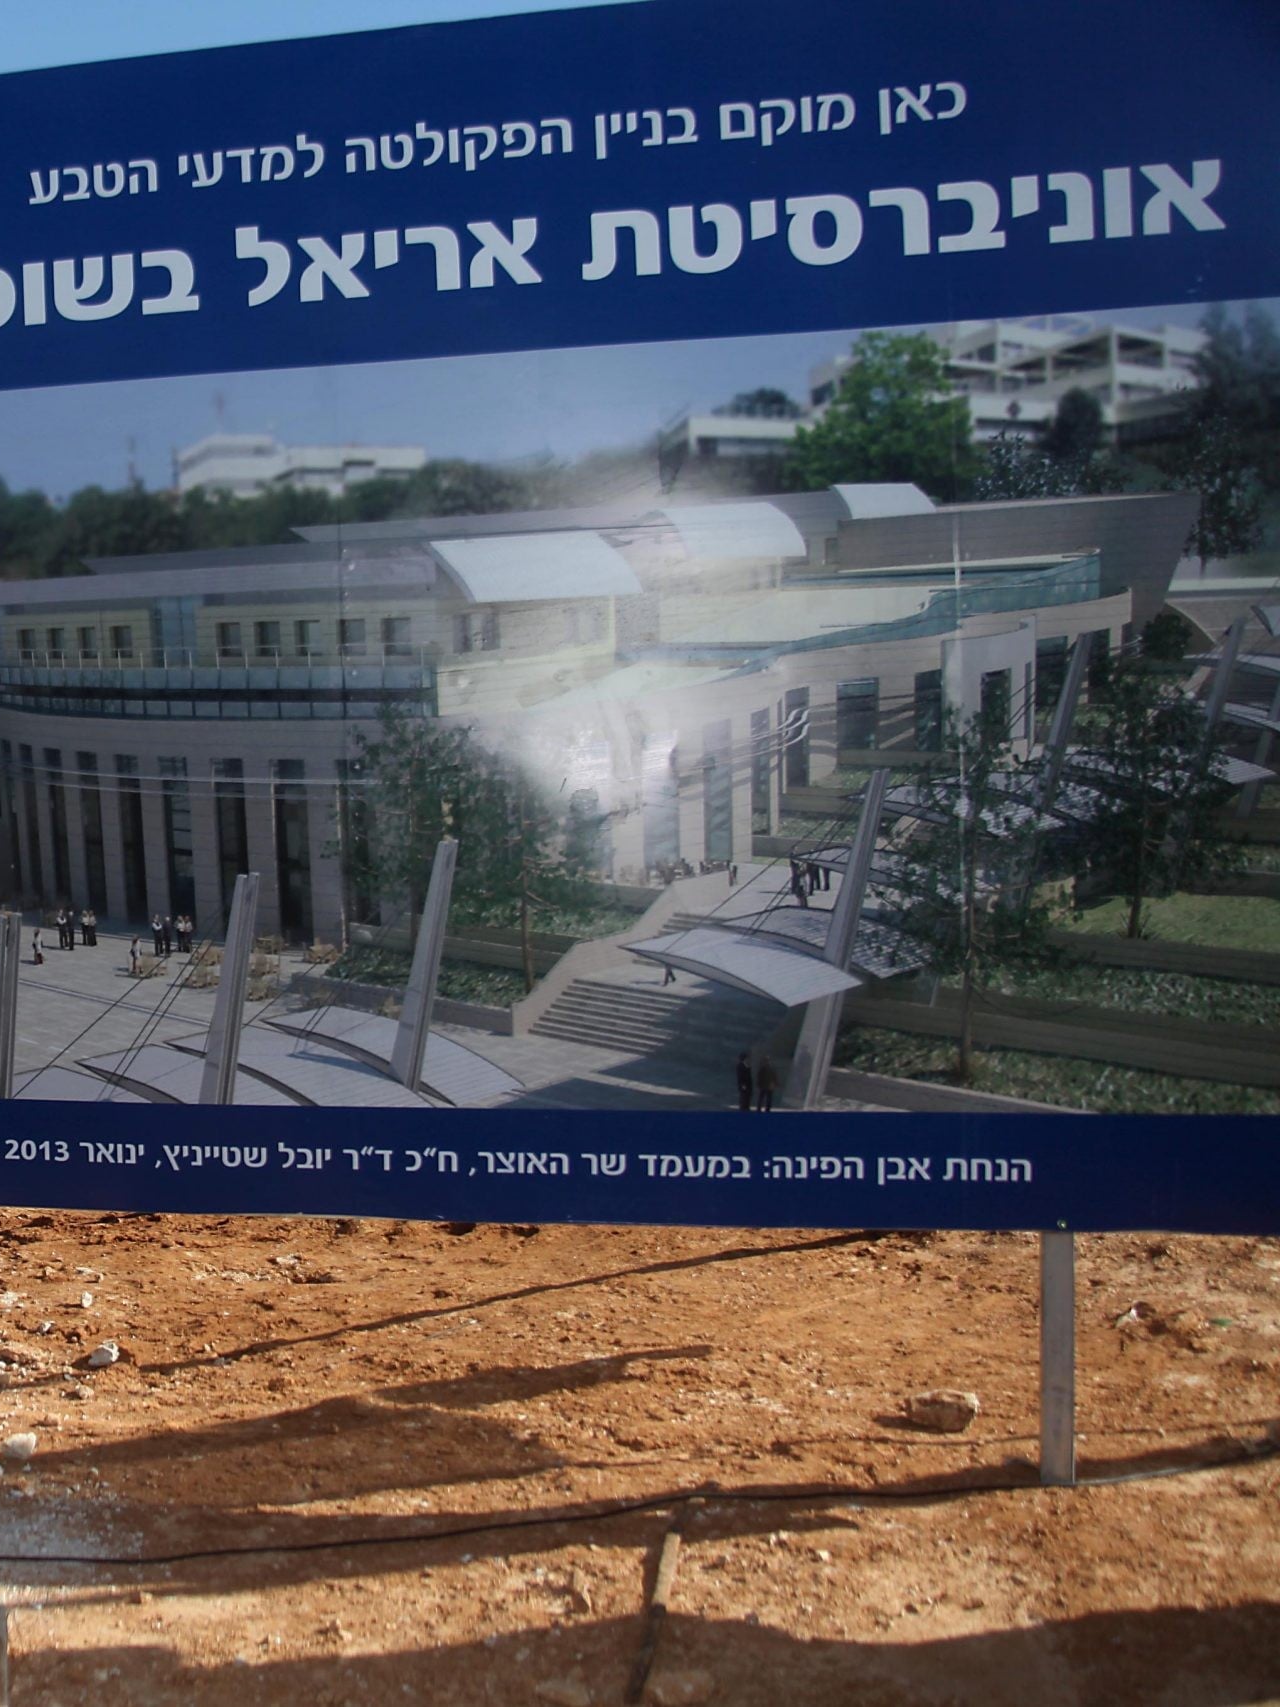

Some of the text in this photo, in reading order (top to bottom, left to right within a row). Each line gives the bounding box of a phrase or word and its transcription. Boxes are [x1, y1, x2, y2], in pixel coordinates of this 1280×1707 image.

[30, 83, 966, 204] כאן מוקם בניין הפקולטה למדעי הטבע
[583, 160, 1225, 280] אוניברסיטת
[236, 218, 542, 306] אריאל
[5, 1140, 69, 1161] 2013
[80, 1143, 144, 1163] ינואר
[155, 1146, 266, 1170] שטייניץ,
[278, 1143, 330, 1168] יובל
[469, 1152, 568, 1176] האוצר,
[582, 1154, 625, 1175] שר
[639, 1155, 750, 1177] במעמד
[764, 1157, 863, 1178] הפינה:
[879, 1158, 930, 1185] אבן
[944, 1159, 1031, 1181] הנחת
